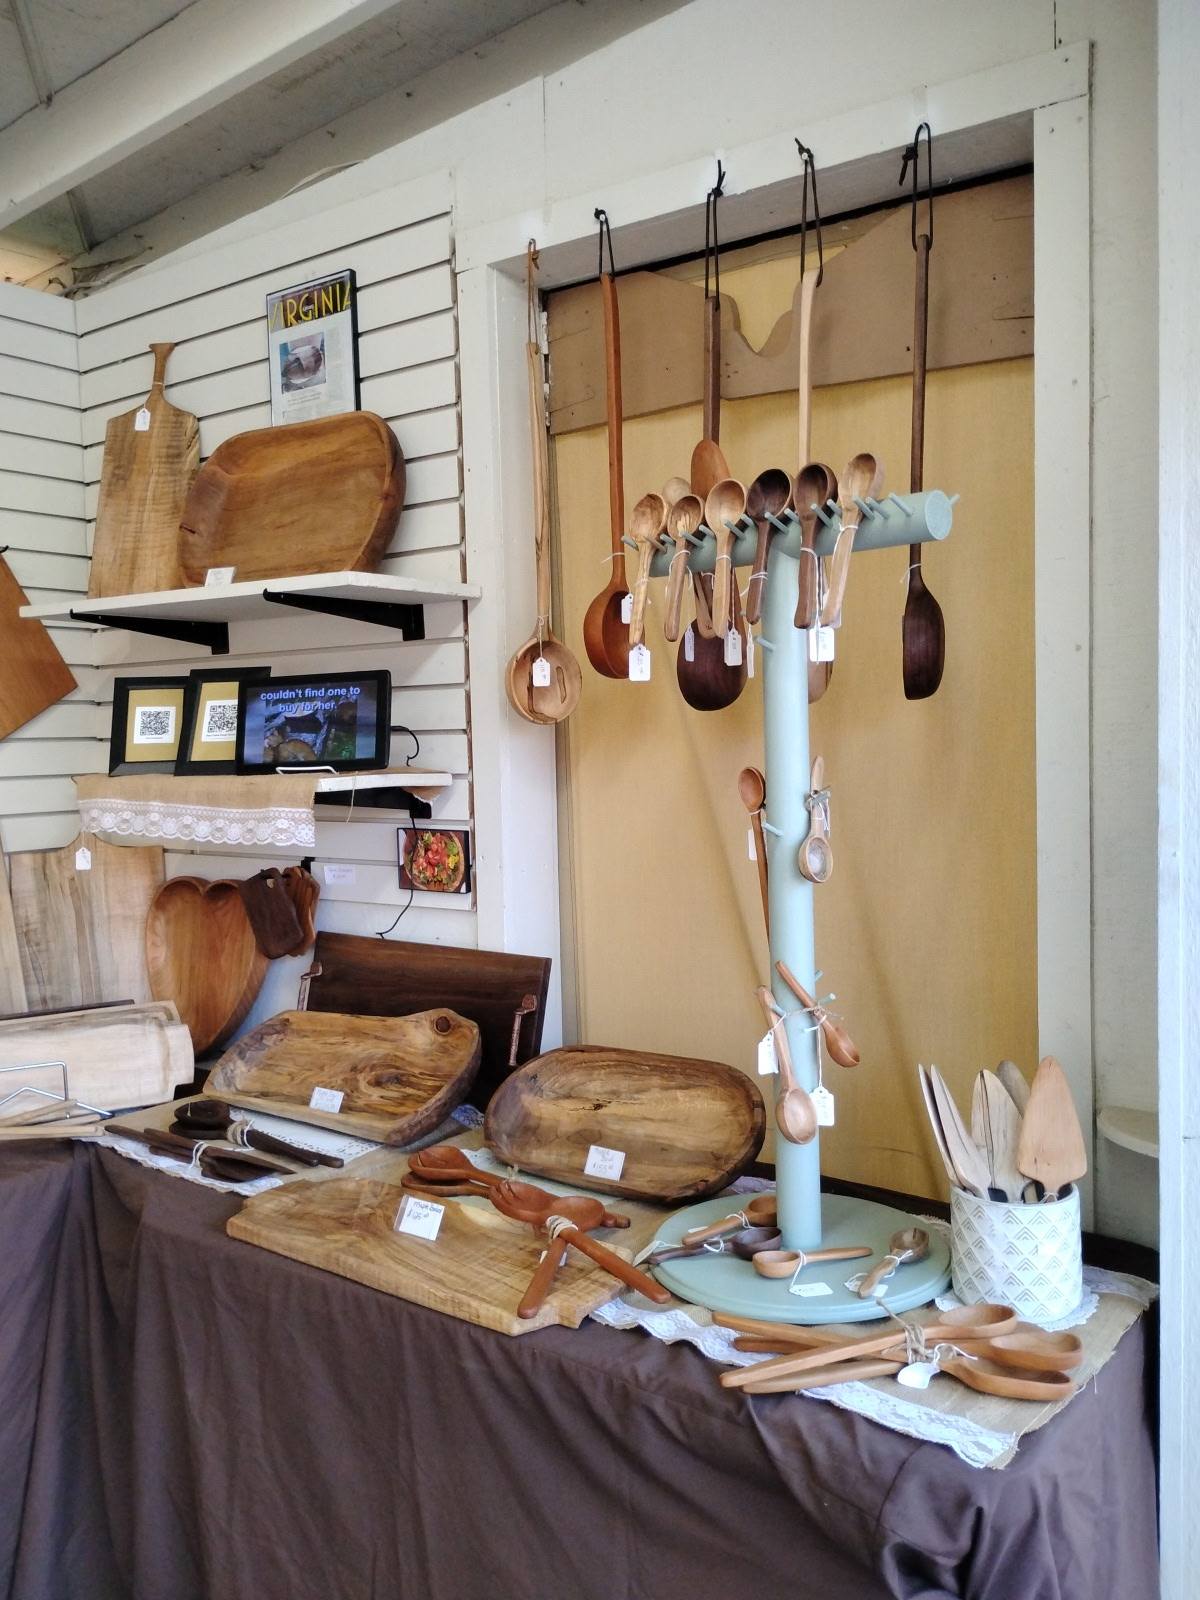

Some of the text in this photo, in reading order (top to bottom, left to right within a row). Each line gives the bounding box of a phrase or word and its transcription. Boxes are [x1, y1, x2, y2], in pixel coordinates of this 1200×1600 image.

[260, 686, 361, 700] couldn't find one to
[280, 701, 337, 714] buy for her.
